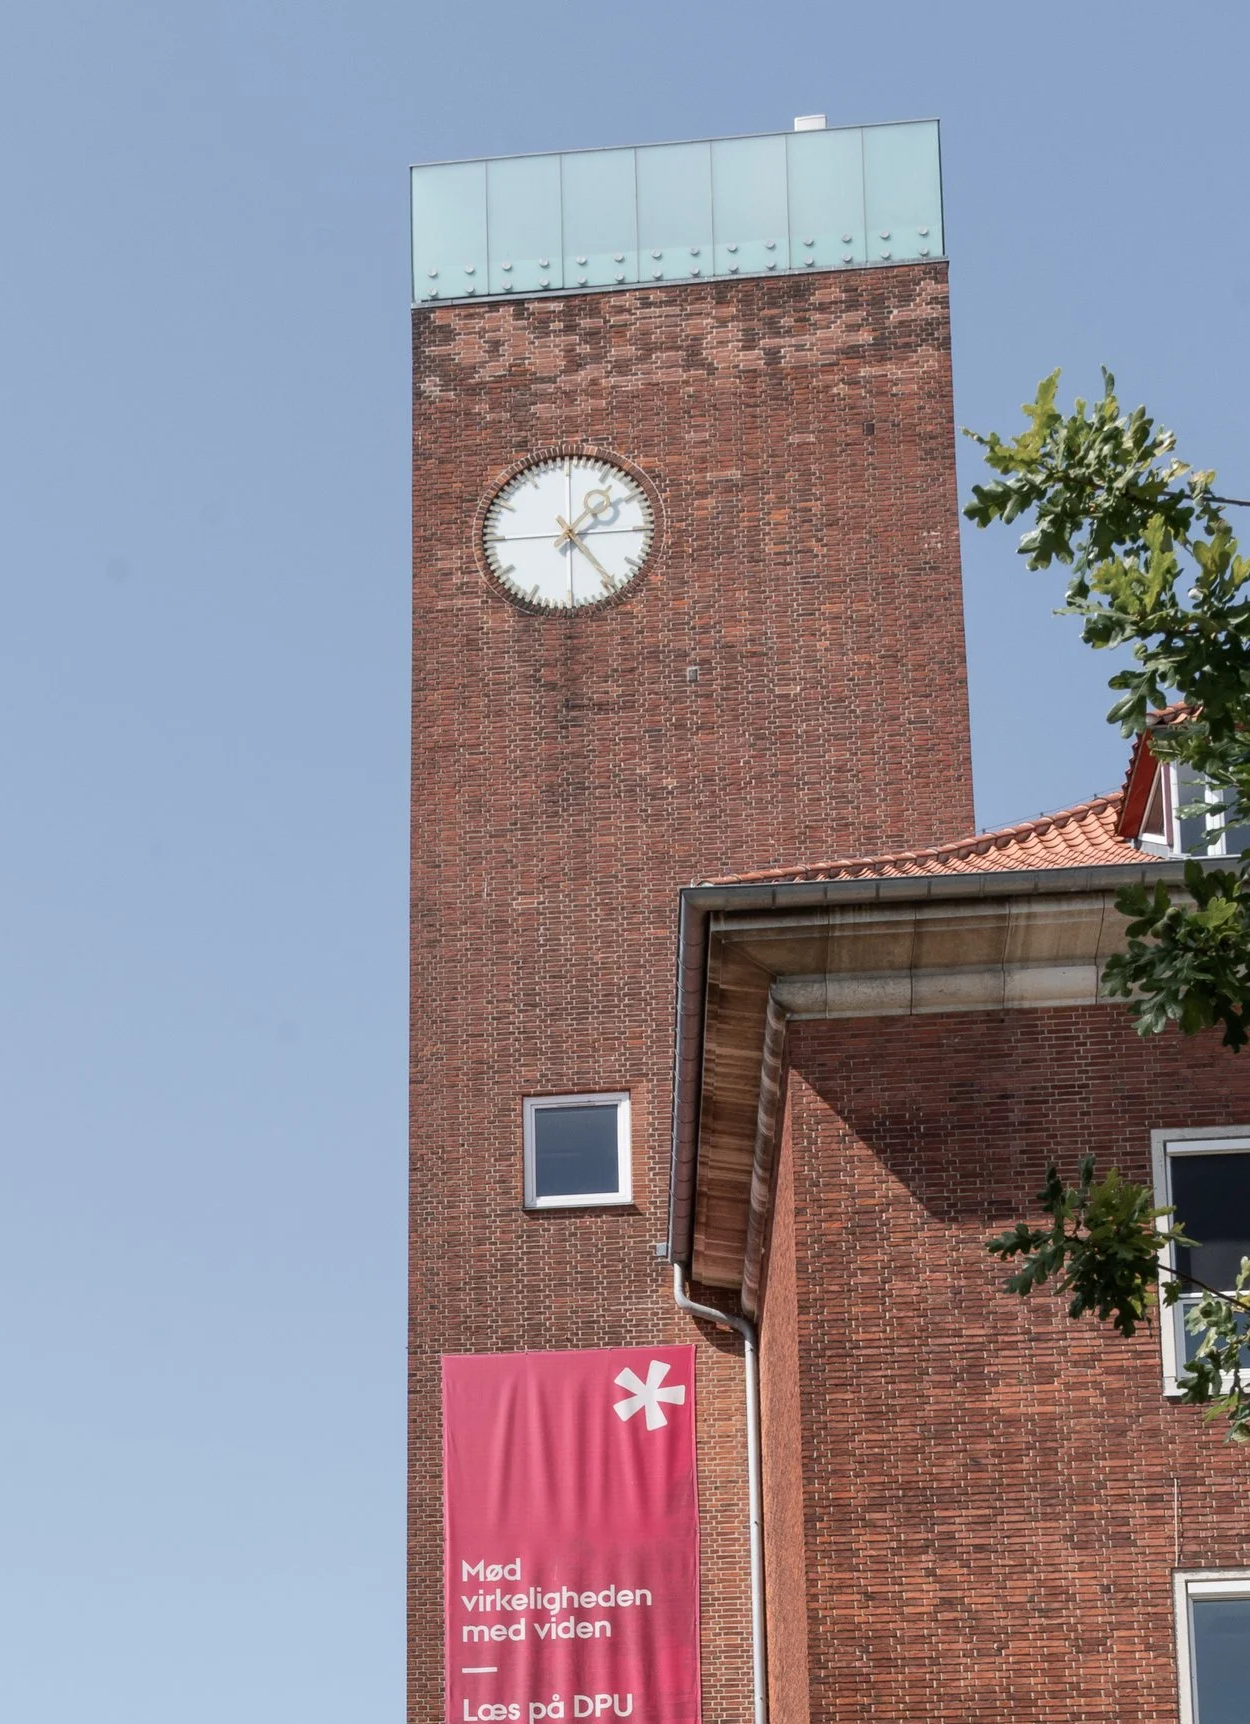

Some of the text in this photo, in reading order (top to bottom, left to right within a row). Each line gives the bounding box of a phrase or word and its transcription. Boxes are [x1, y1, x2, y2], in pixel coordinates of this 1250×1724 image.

[461, 1557, 521, 1582] Mød
[461, 1584, 652, 1615] virkeligheden
[462, 1615, 611, 1642] med viden
[462, 1693, 634, 1724] Læs på DPU
